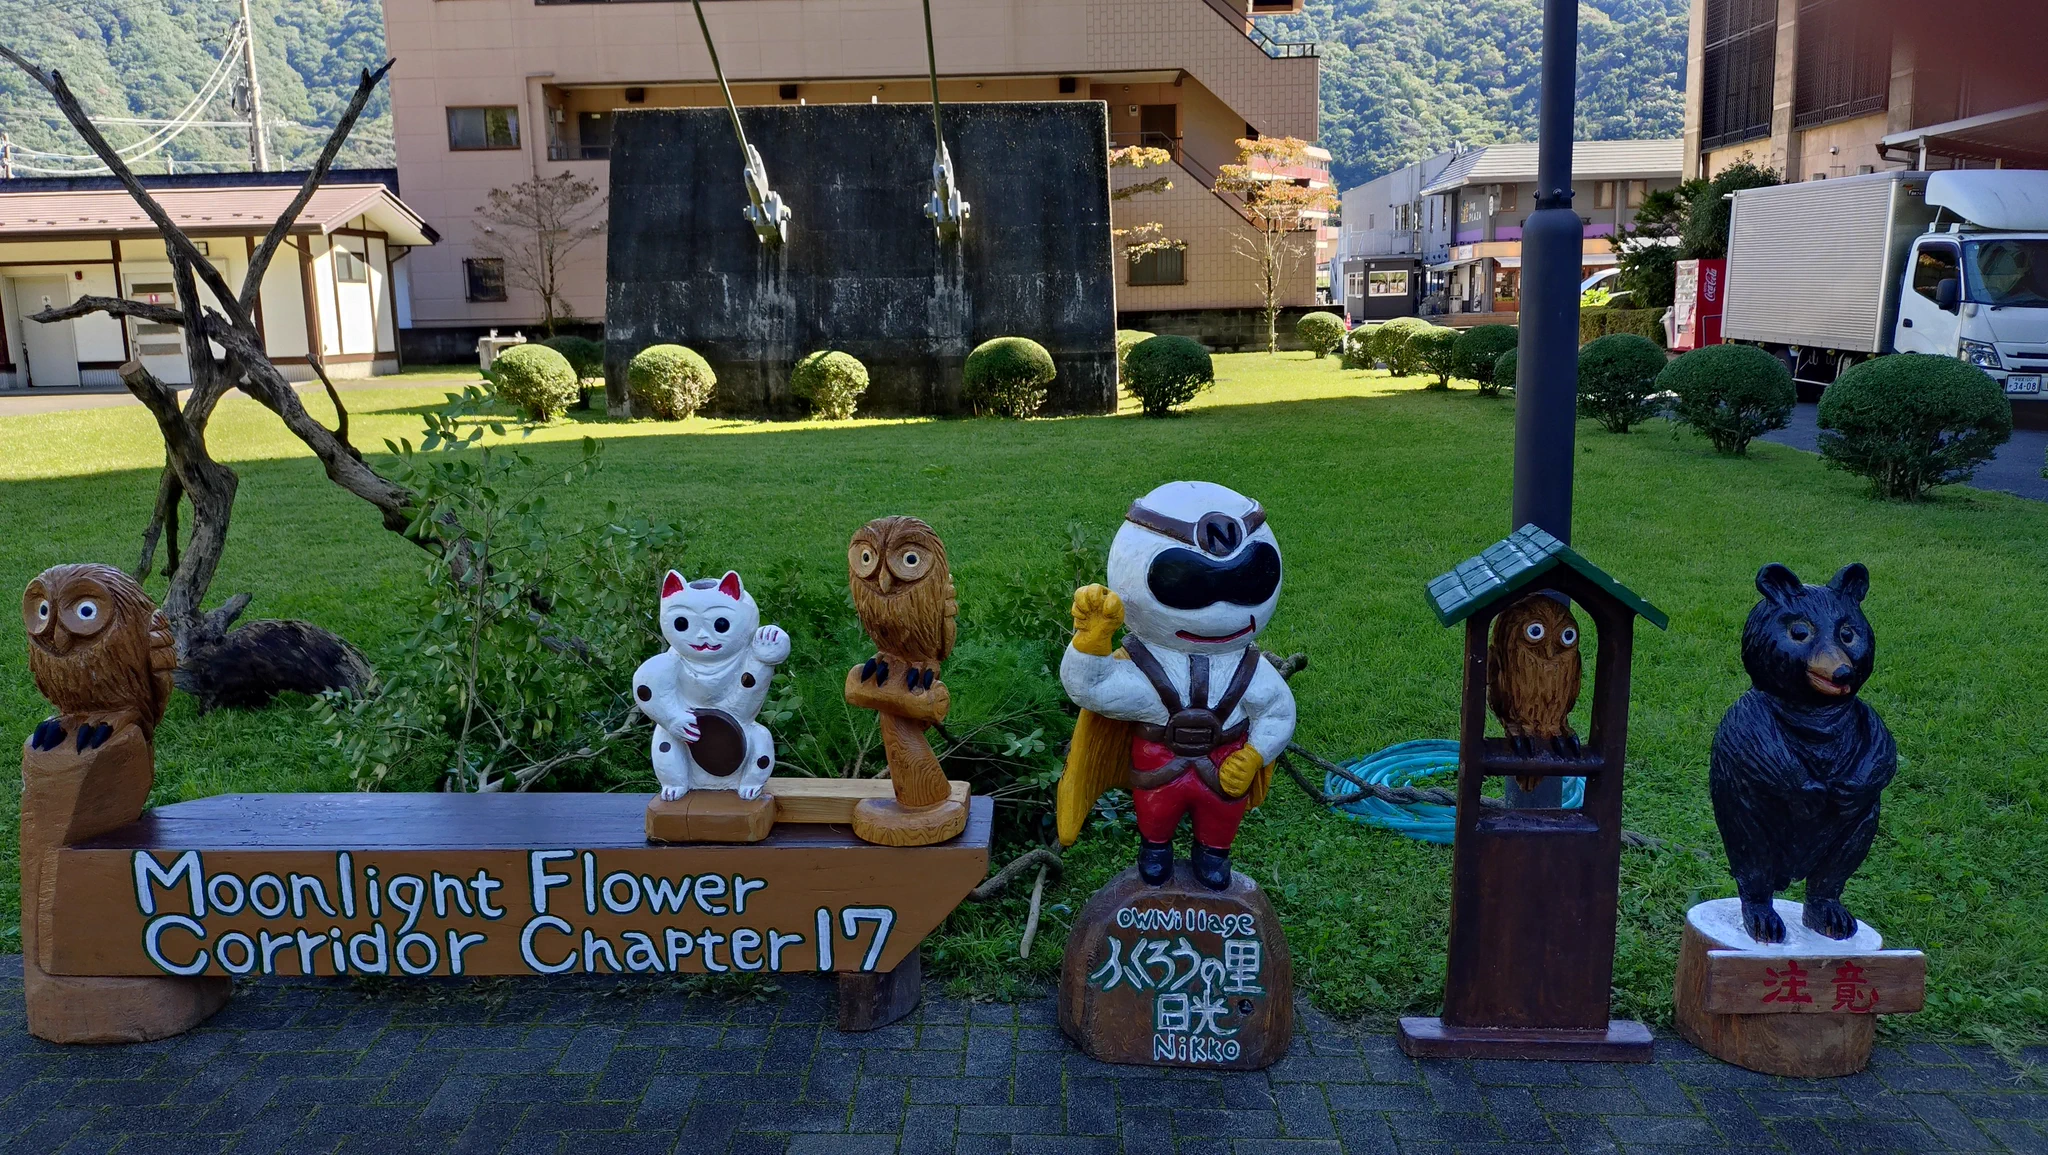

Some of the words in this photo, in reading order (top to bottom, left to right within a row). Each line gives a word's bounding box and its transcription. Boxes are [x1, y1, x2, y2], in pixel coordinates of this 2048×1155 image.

[1206, 522, 1236, 552] N
[529, 849, 768, 916] Flower
[143, 913, 488, 976] Corridor
[520, 915, 806, 974] Chapter
[815, 906, 897, 973] 17
[1091, 936, 1263, 993] ふくろうの里
[1762, 959, 1880, 1012] 注意
[1157, 992, 1240, 1036] 日光
